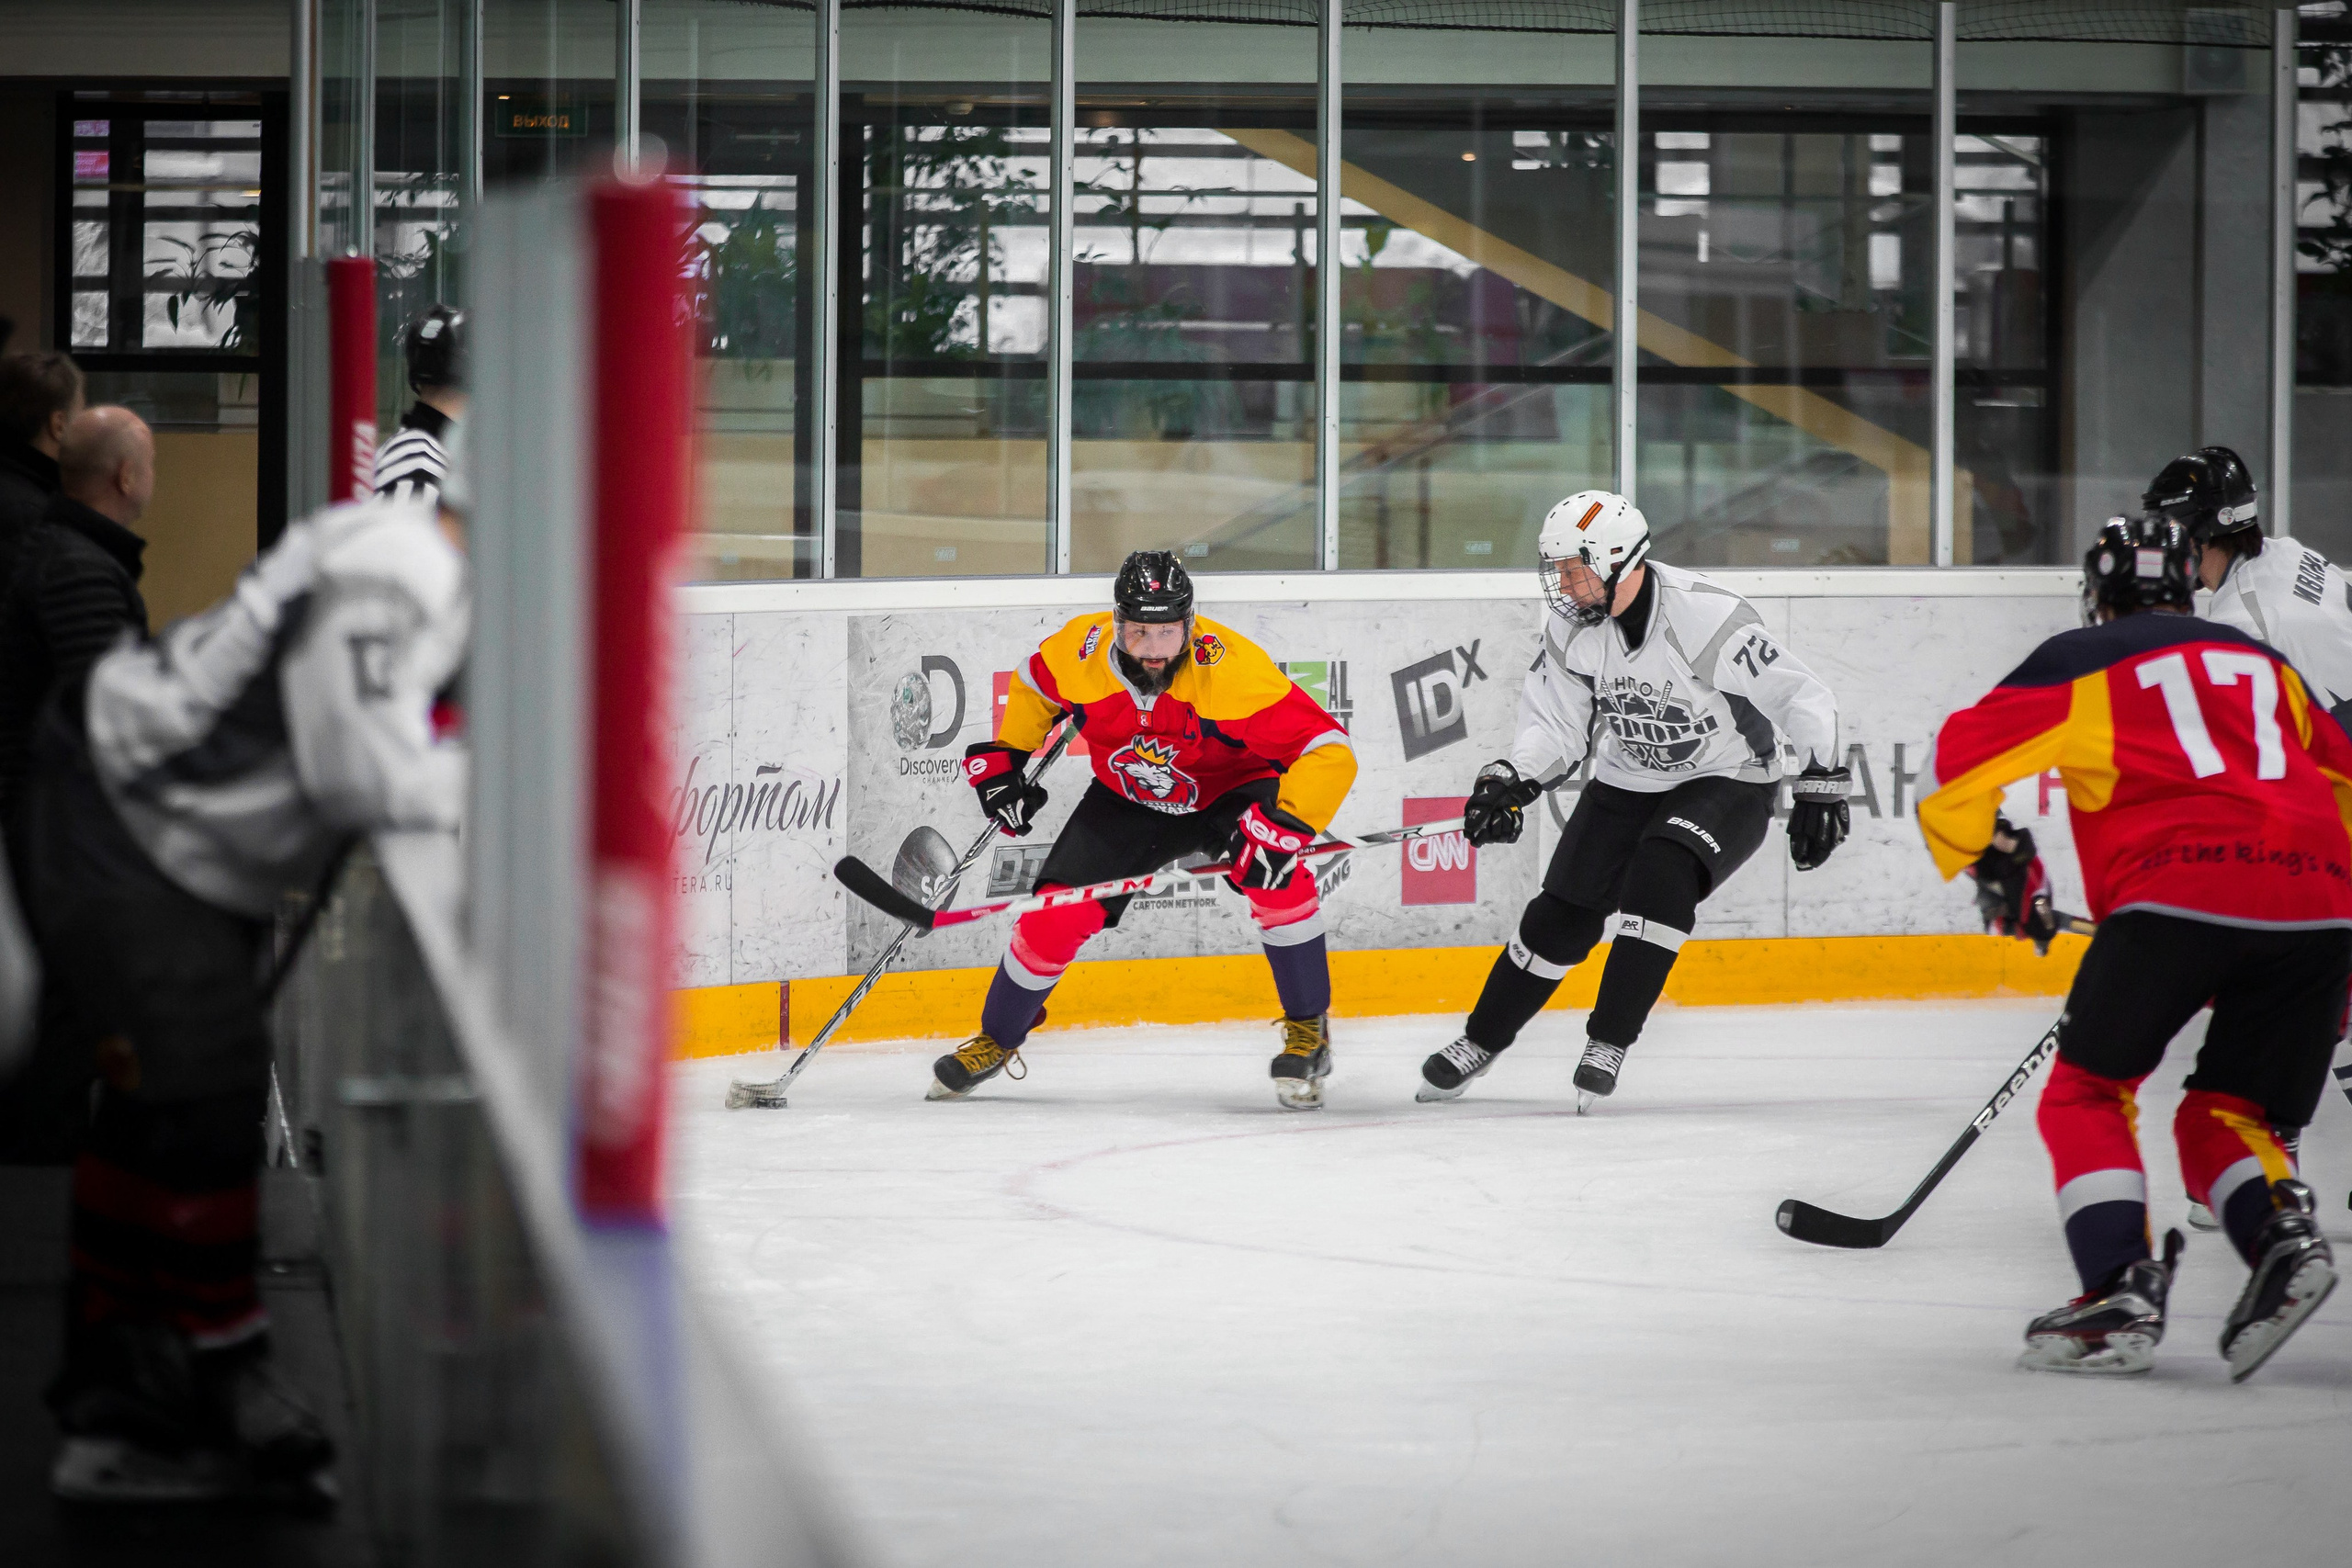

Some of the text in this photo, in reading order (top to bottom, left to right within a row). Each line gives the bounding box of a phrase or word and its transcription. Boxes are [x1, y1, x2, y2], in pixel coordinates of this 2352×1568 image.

[513, 115, 570, 129] ВЫХОД
[1732, 635, 1780, 678] 72
[2135, 649, 2287, 781] 17
[899, 757, 962, 783] Discovery
[1667, 816, 1722, 854] BAUER
[1133, 898, 1217, 911] CARTOON NETWORK
[1972, 1023, 2059, 1134] Reebo
